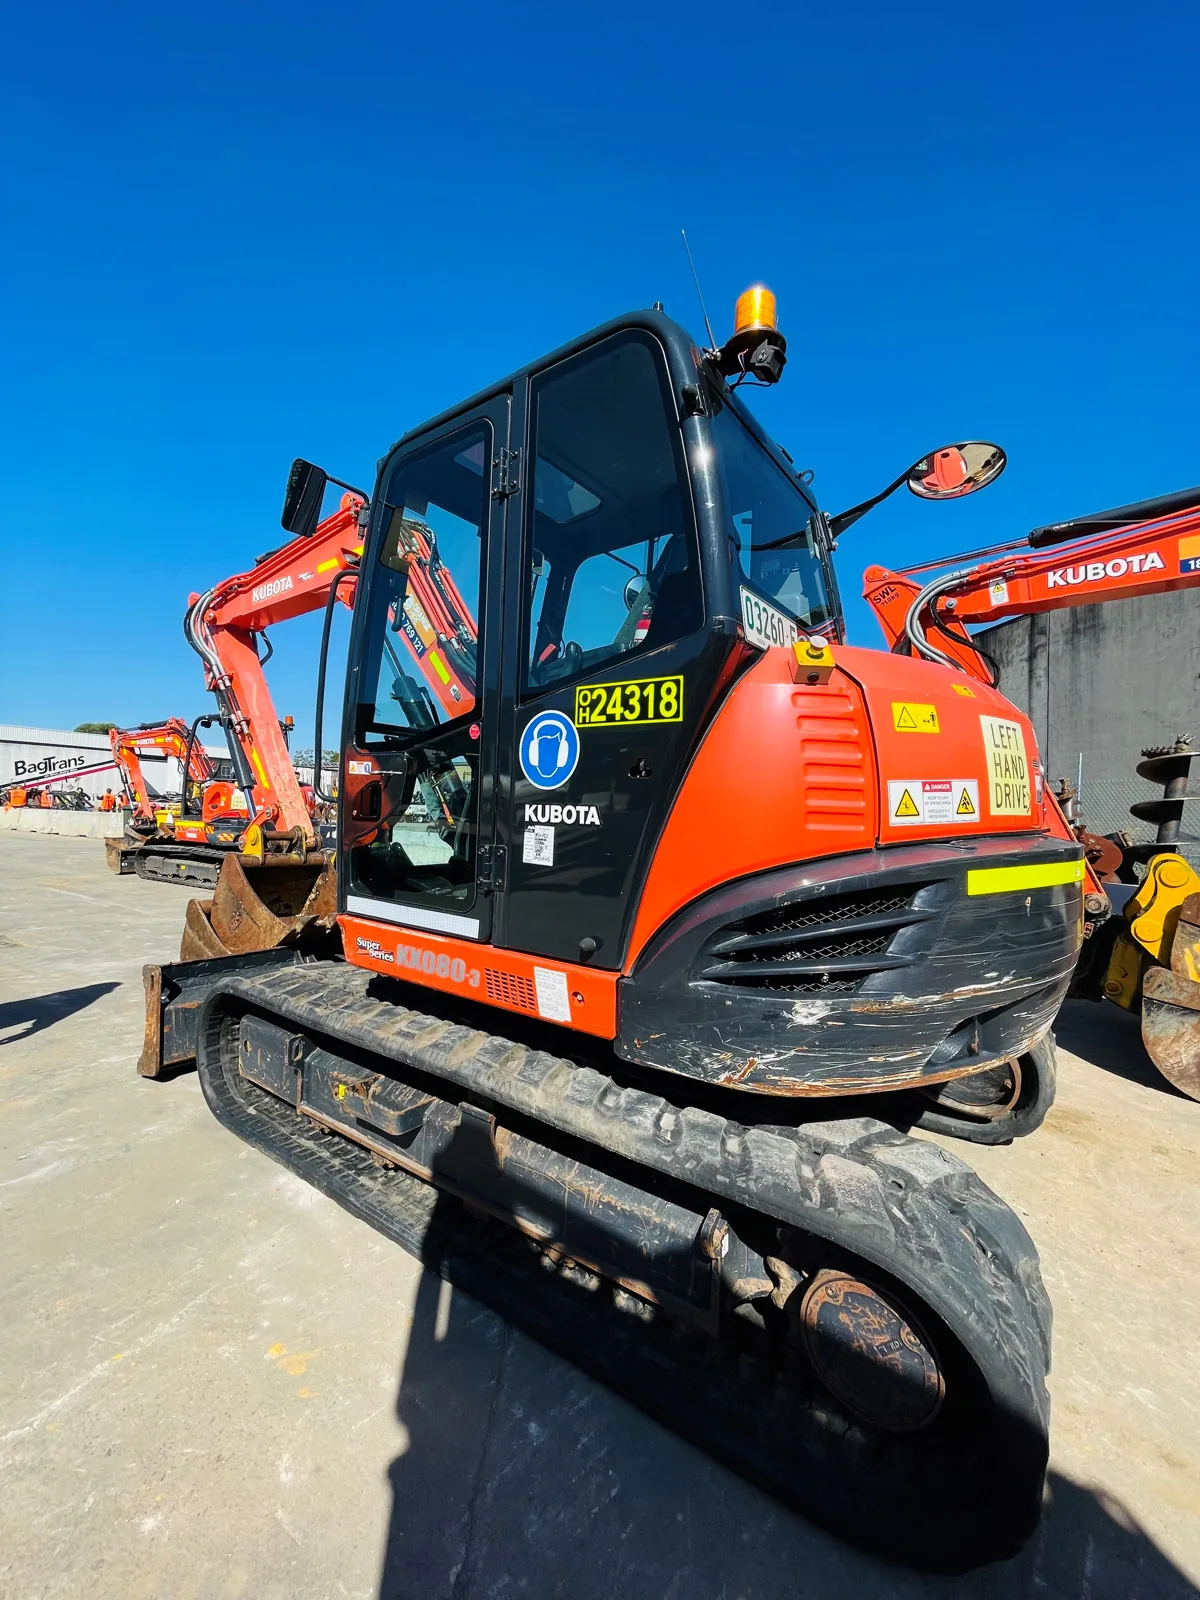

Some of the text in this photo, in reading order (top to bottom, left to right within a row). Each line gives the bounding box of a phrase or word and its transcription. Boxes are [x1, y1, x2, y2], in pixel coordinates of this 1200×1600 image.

[1046, 551, 1166, 589] KUBOTA
[252, 575, 293, 604] KUBOTA
[873, 585, 896, 604] SWL
[880, 592, 900, 607] 710kg
[412, 602, 431, 632] ORANGE
[403, 620, 424, 653] 769 121
[590, 681, 678, 722] 24318
[990, 723, 1019, 751] LEFT
[14, 755, 85, 776] BagTrans
[993, 752, 1024, 780] HAND
[994, 782, 1028, 809] DRIVE
[524, 804, 601, 825] KUBOTA
[356, 937, 381, 951] Super
[368, 949, 394, 962] Series
[396, 944, 480, 988] KX080-3
